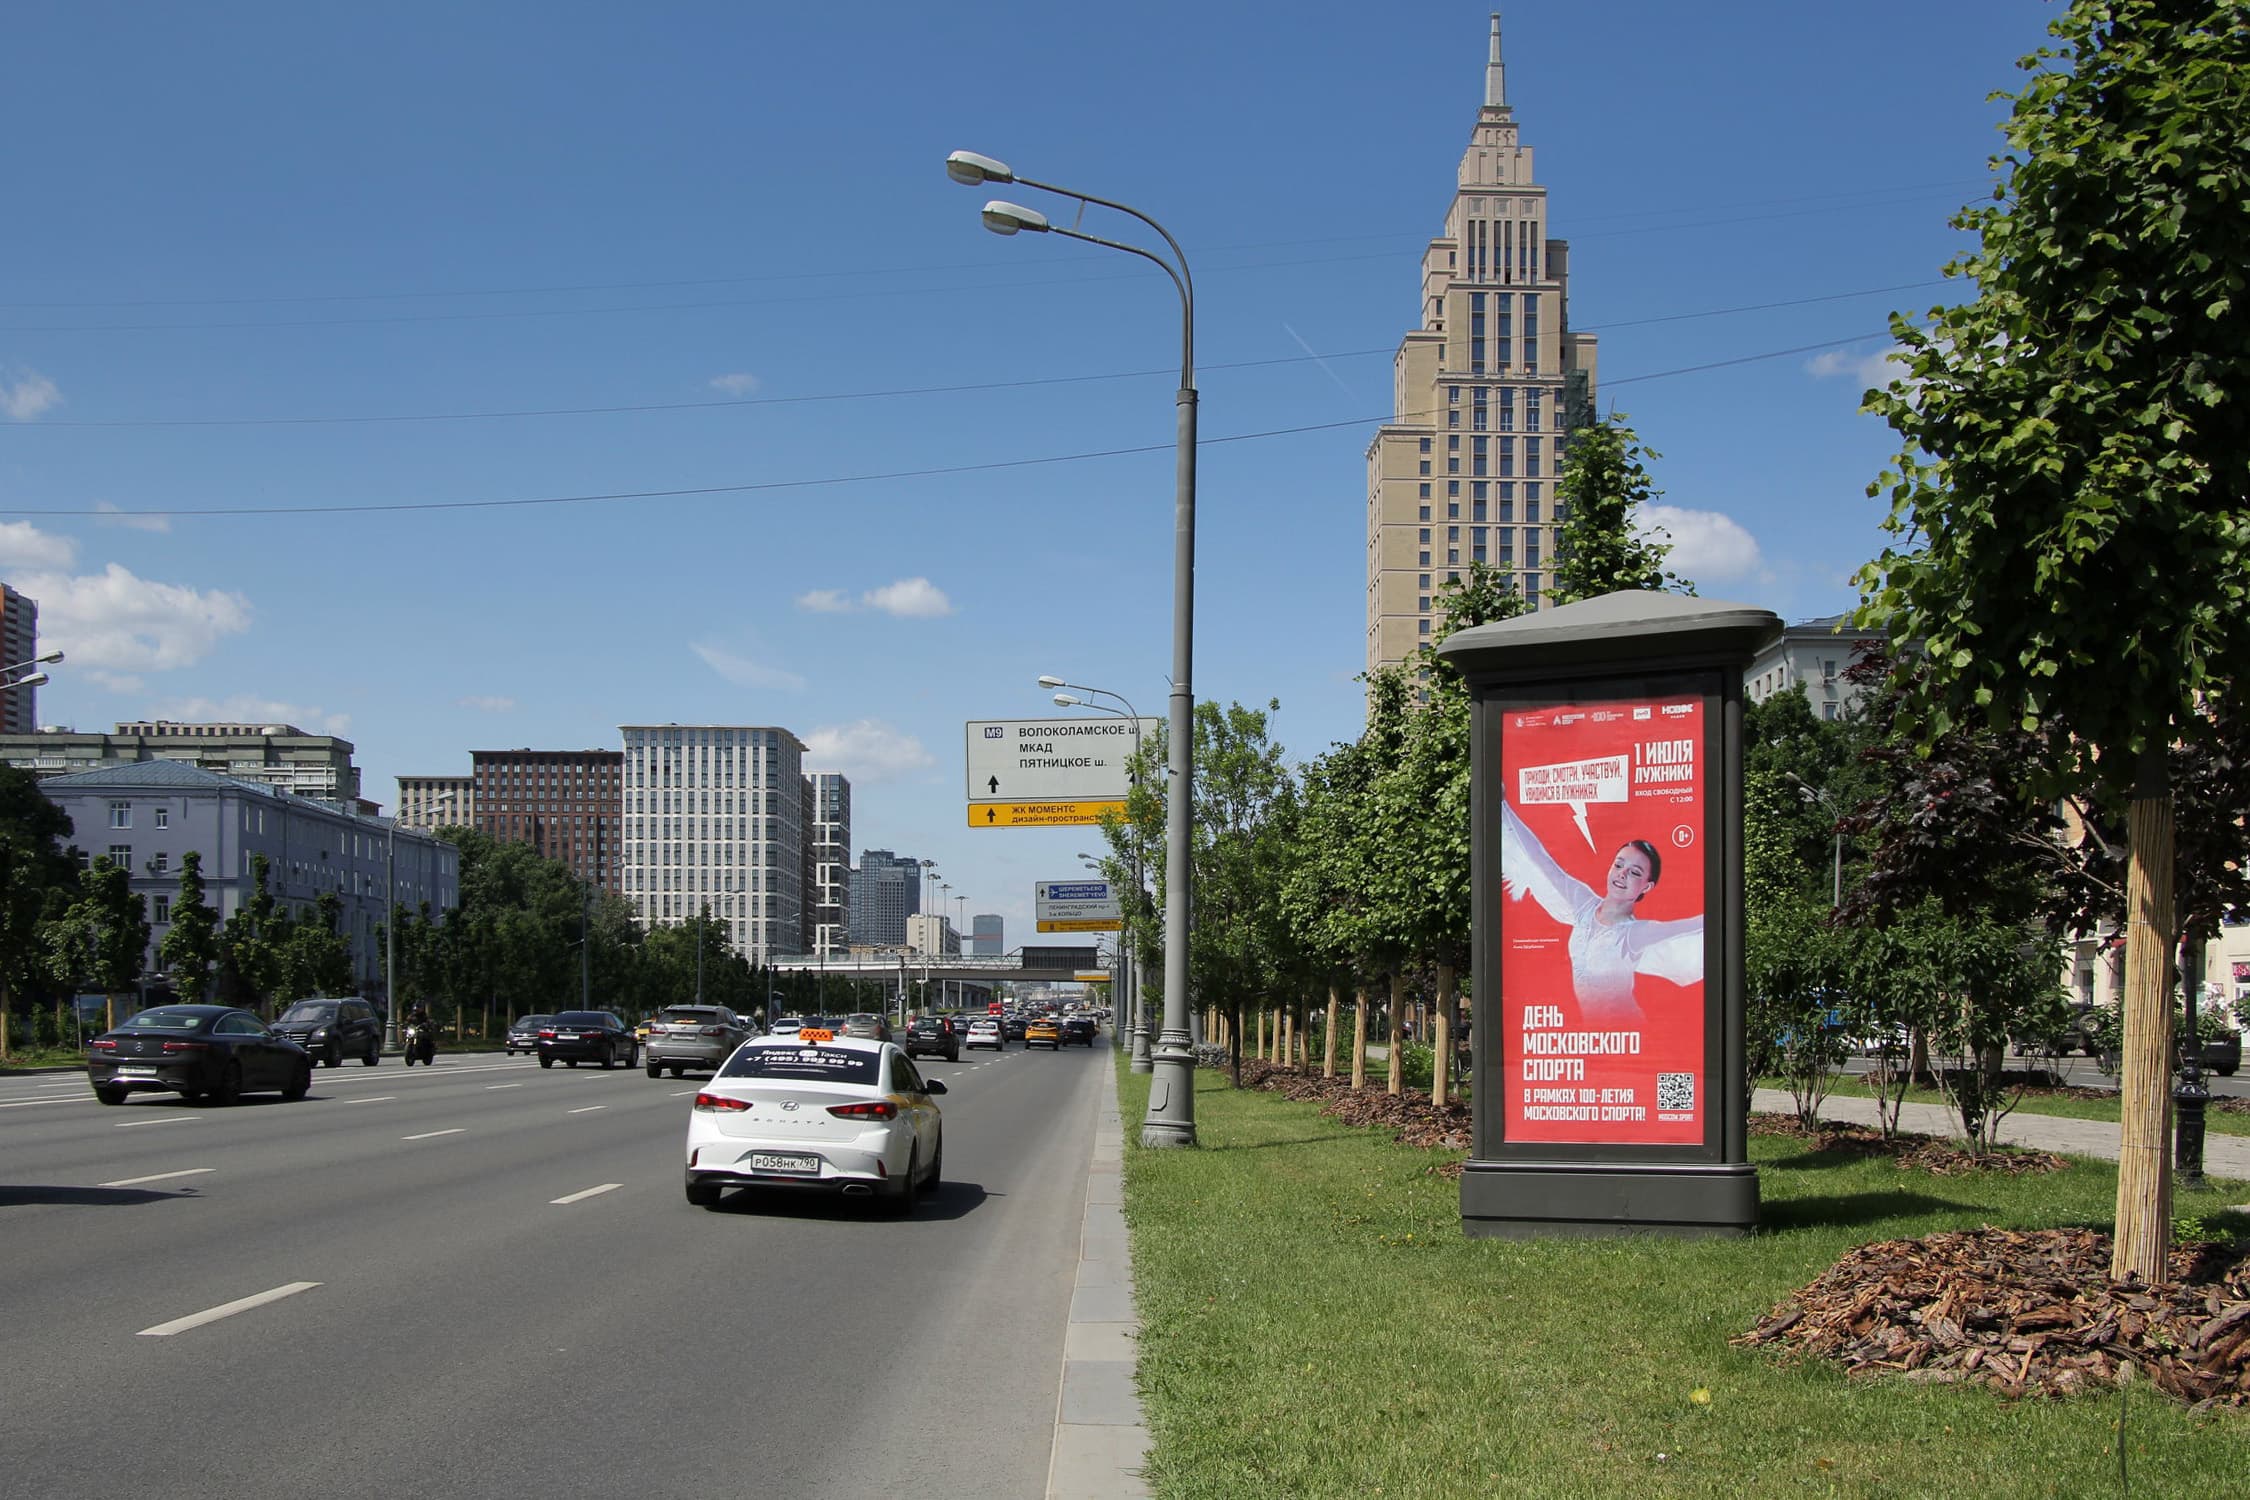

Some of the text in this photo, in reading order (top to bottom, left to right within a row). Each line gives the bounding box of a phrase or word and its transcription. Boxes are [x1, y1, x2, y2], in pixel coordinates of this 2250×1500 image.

[1019, 725, 1125, 738] ВОЛОКОЛАМСКОЕ
[1019, 743, 1053, 754] МКАД
[1634, 740, 1693, 765] 1 ИЮЛЯ
[1019, 757, 1108, 769] ПЯТНИЦКОЕ ш.
[1634, 764, 1693, 784] ЛУЖНИКИ
[1653, 787, 1693, 795] СВОБОДНЫЙ
[1011, 805, 1076, 814] ЖК МОМЕНТС
[1678, 830, 1689, 842] 0+
[1523, 1005, 1564, 1030] ДЕНЬ
[1523, 1032, 1640, 1055] МОСКОВСКОГО
[820, 1051, 847, 1059] Такси
[1523, 1059, 1585, 1081] СПОРТА
[1524, 1088, 1634, 1103] В РАМКАХ 100-ЛЕТИЯ
[1524, 1106, 1646, 1121] МОСКОВСКОГО СПОРТА!
[800, 1158, 815, 1167] 790
